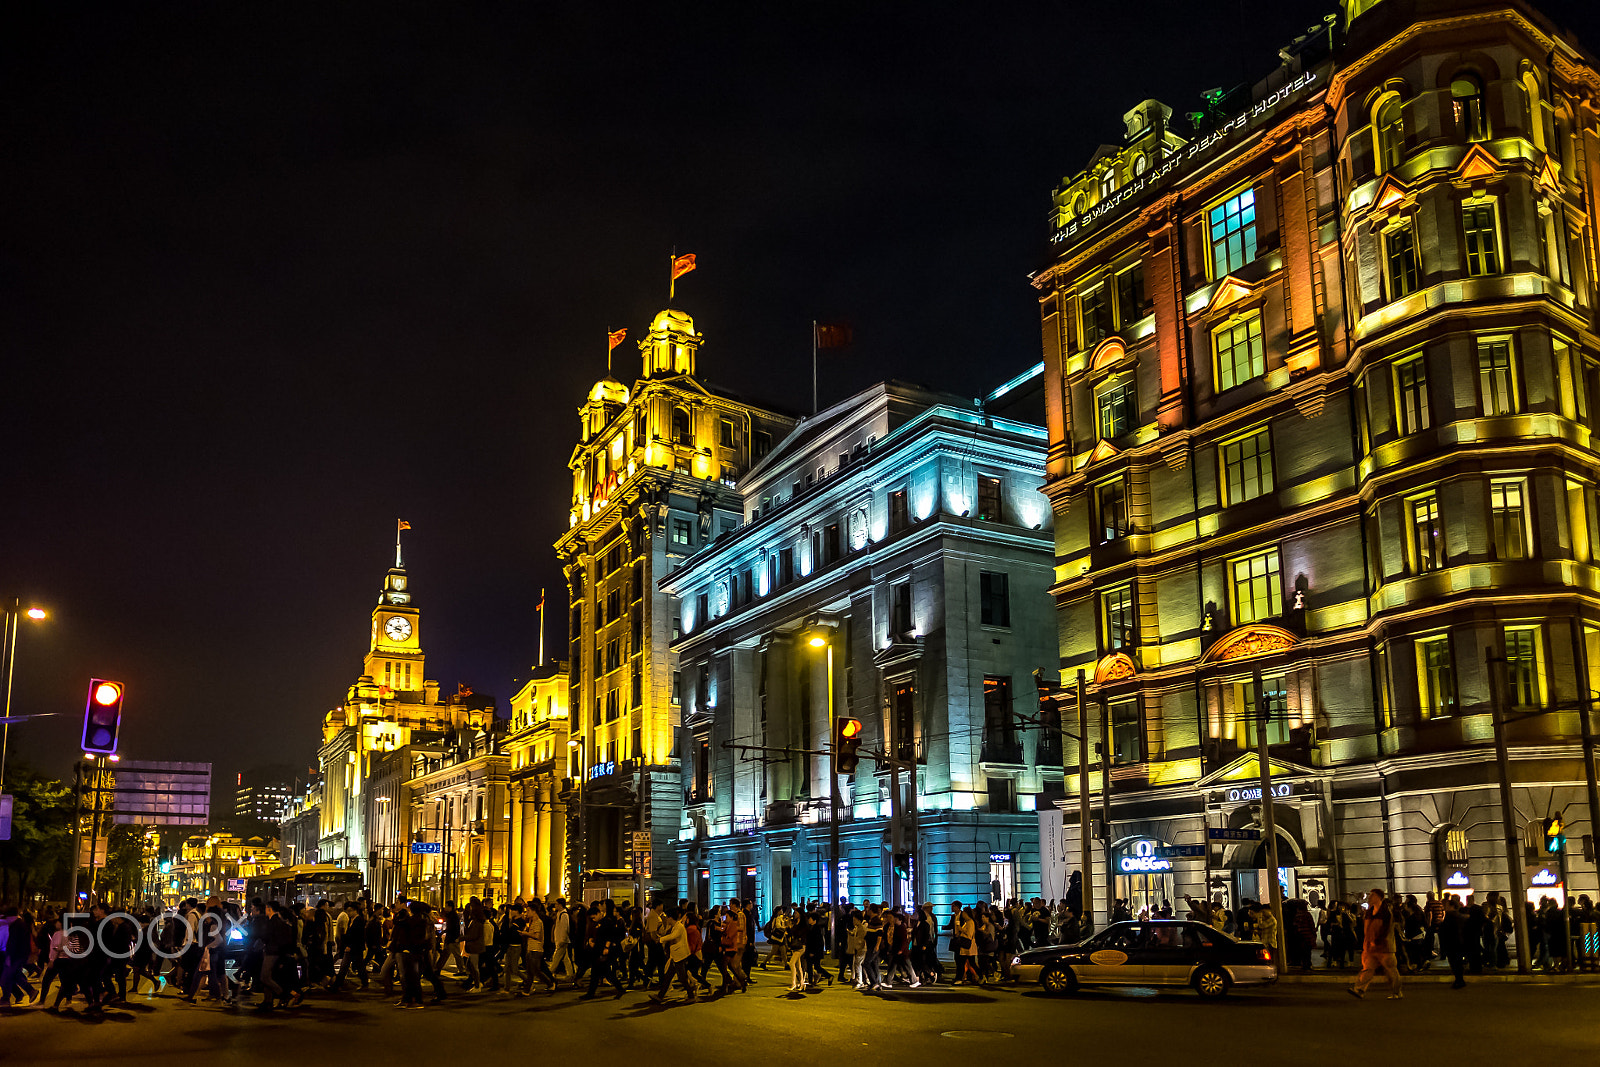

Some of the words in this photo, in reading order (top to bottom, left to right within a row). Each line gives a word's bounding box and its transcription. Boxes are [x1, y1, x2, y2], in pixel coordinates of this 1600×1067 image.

[1050, 222, 1078, 246] THE
[1081, 179, 1145, 228] SWATCH
[1148, 153, 1183, 185] ART
[1187, 112, 1247, 159] PEACE
[1252, 71, 1317, 118] HOTEL
[592, 470, 618, 514] AIA
[1241, 787, 1277, 800] OMEA
